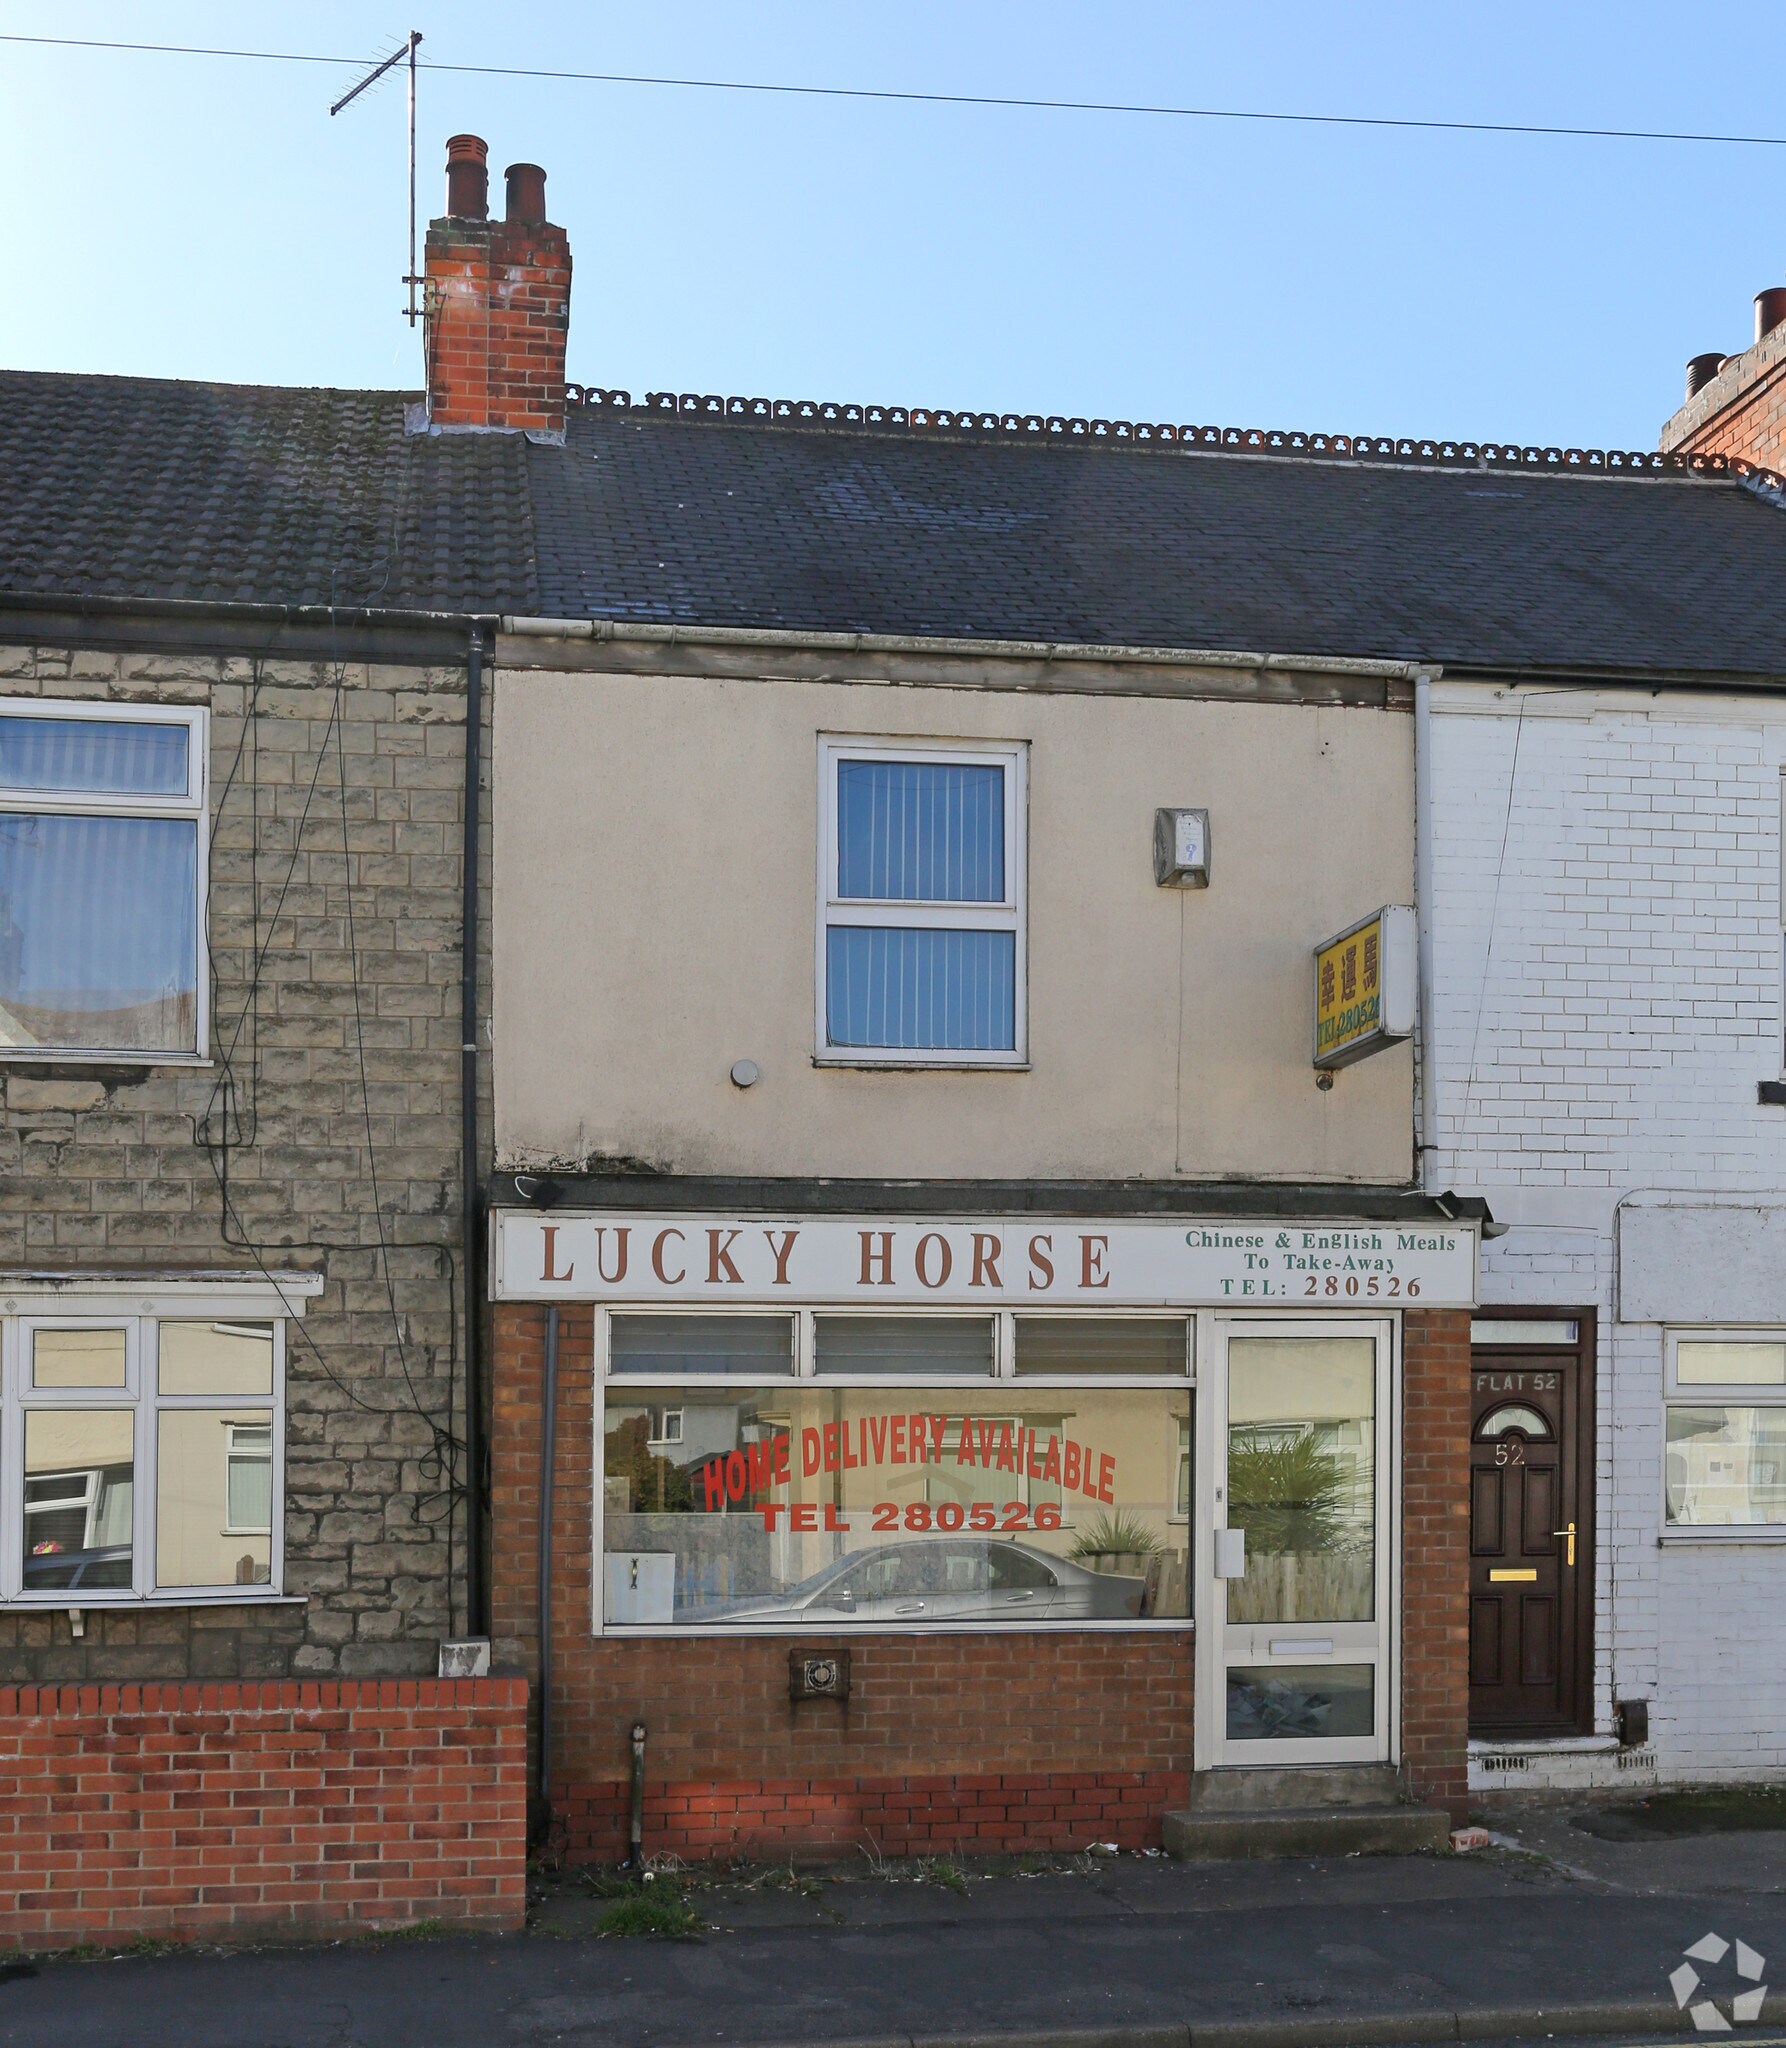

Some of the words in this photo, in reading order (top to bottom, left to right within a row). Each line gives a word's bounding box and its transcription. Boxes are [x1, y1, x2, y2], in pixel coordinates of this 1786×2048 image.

[1185, 1231, 1264, 1249] Chinese
[1274, 1232, 1292, 1249] &
[1301, 1231, 1383, 1251] English
[1396, 1234, 1456, 1251] Meals
[539, 1226, 801, 1285] LUCKY
[856, 1231, 1111, 1291] HORSE
[1243, 1253, 1269, 1270] To
[1283, 1253, 1395, 1274] Take-Away
[1220, 1278, 1288, 1296] TEL:
[1304, 1275, 1422, 1298] 280526
[1476, 1374, 1524, 1392] FLAT
[1533, 1373, 1557, 1391] 52
[703, 1432, 792, 1513] HOME
[801, 1413, 949, 1478] DELIVERY
[956, 1415, 1116, 1506] AVAILABLE
[1494, 1443, 1526, 1466] 52
[754, 1502, 851, 1533] TEL
[871, 1501, 1063, 1533] 280526
